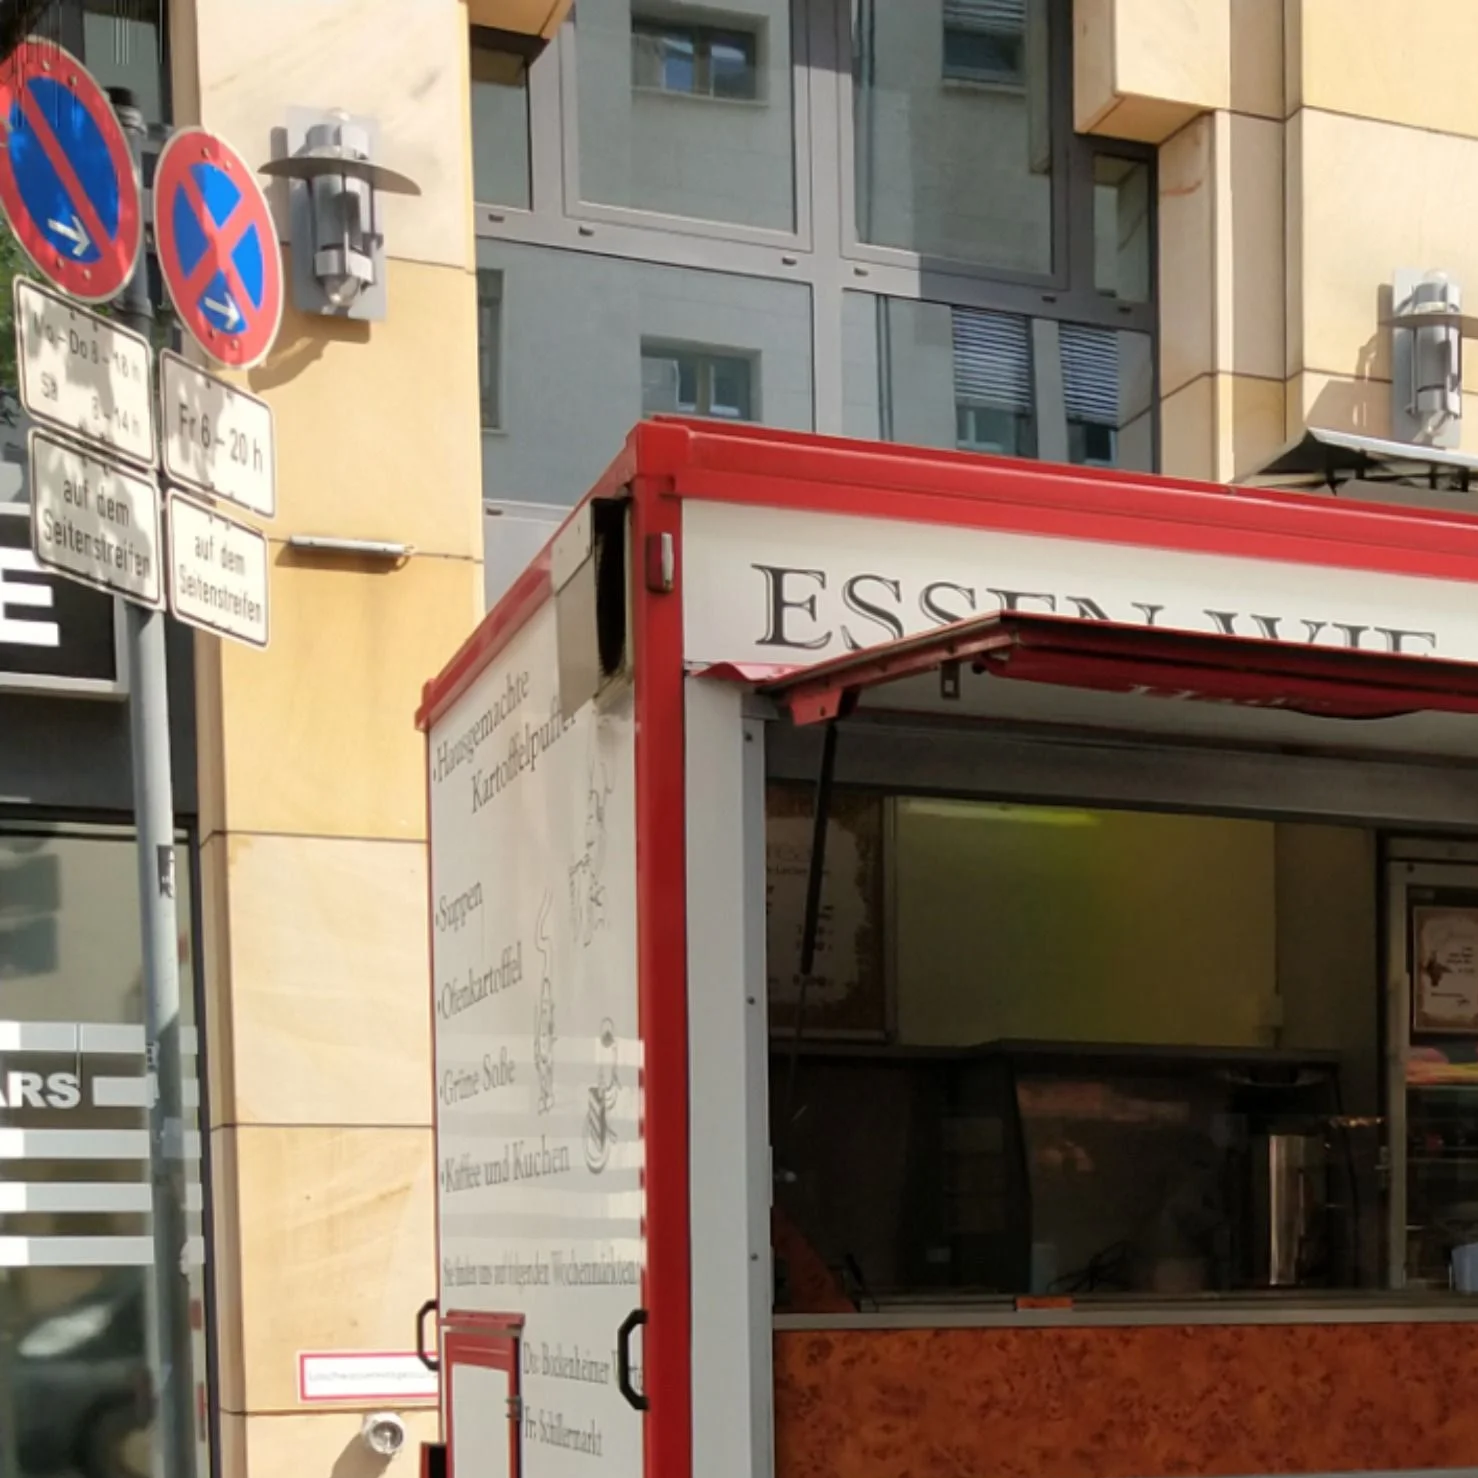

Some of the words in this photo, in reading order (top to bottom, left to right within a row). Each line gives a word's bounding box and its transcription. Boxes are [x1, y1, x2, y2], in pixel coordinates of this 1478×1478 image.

[40, 371, 58, 402] Sa
[178, 401, 197, 441] Fr
[253, 437, 264, 473] h
[63, 478, 89, 511] auf
[97, 484, 129, 528] dem
[43, 508, 150, 579] Seitenstreifen
[194, 531, 215, 561] auf
[220, 543, 246, 577] dem
[178, 562, 263, 624] Seitenstreifen
[436, 671, 529, 783] Hausgemachte
[439, 880, 483, 934] Suppen
[441, 939, 523, 1021] Ofenkartoffel
[443, 1068, 479, 1107] Grüne
[484, 1143, 510, 1187] und
[512, 1133, 571, 1182] Kuchen
